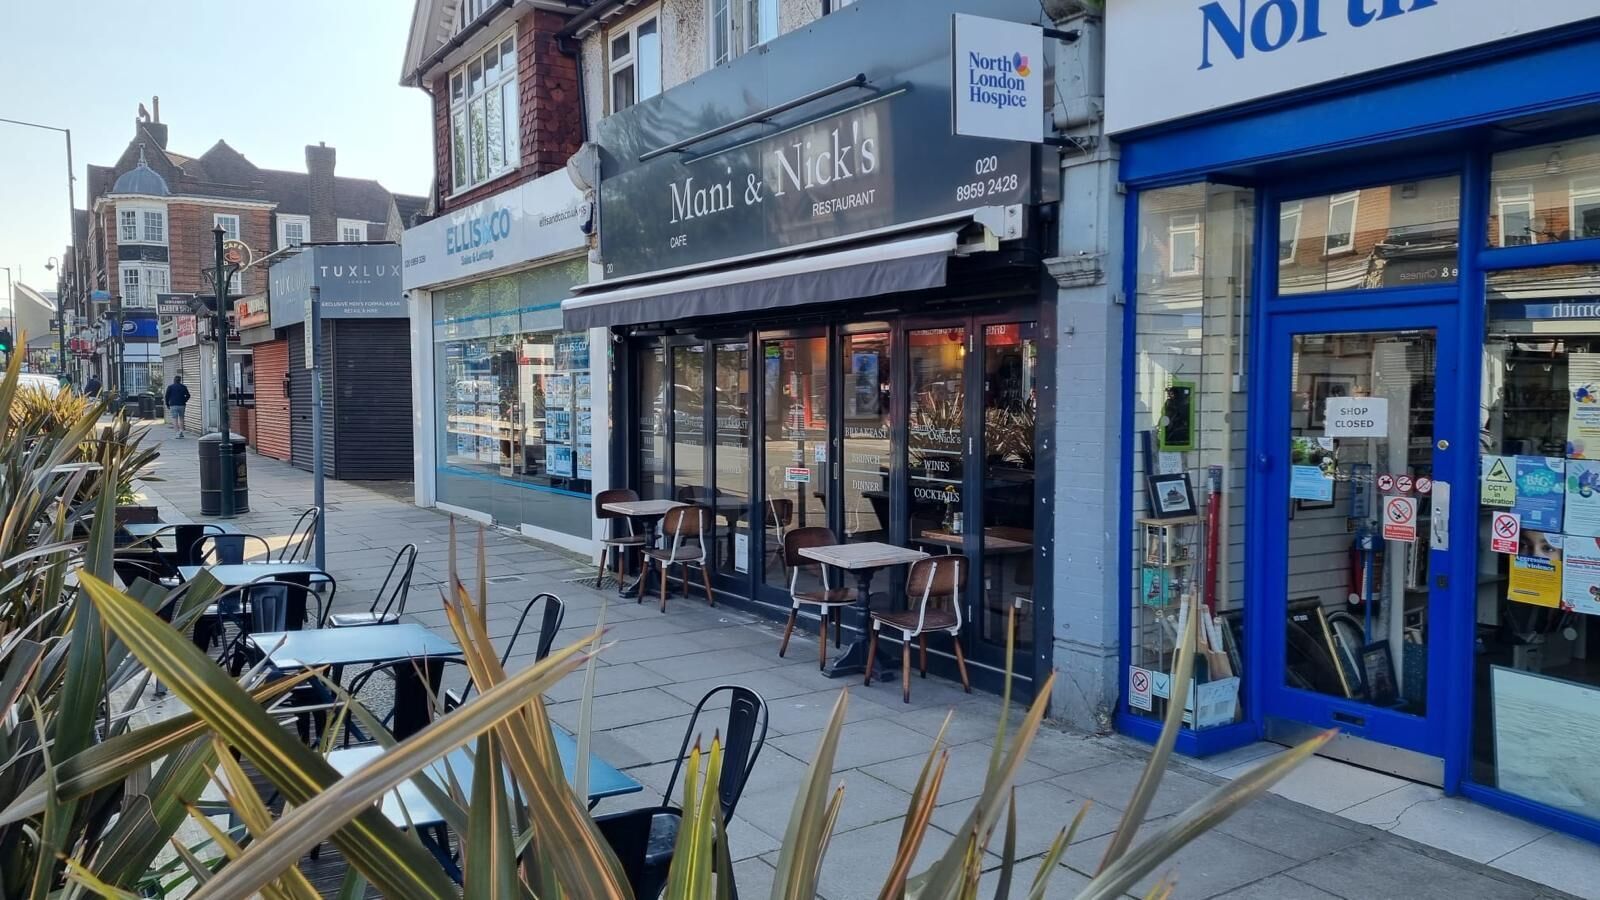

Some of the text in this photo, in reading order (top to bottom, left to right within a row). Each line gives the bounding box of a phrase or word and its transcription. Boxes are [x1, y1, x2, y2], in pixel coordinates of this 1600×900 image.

[1197, 0, 1438, 70] Nor
[969, 51, 1012, 72] North
[969, 69, 1025, 91] London
[970, 86, 1027, 109] Hospice
[975, 155, 998, 175] 020
[669, 121, 876, 224] Mani & Nick's
[956, 174, 1018, 202] 8959 2428
[812, 189, 876, 217] RESTAURANT
[670, 234, 687, 248] CAFE
[320, 265, 400, 277] TUXLUX
[606, 264, 614, 274] 20
[1340, 407, 1369, 416] SHOP
[1335, 420, 1374, 428] CLOSED
[845, 427, 887, 439] BREAKFAST
[924, 460, 950, 472] WINES
[852, 480, 880, 491] DINNER
[1487, 484, 1509, 492] CCTV
[914, 488, 960, 503] COCKTAILS
